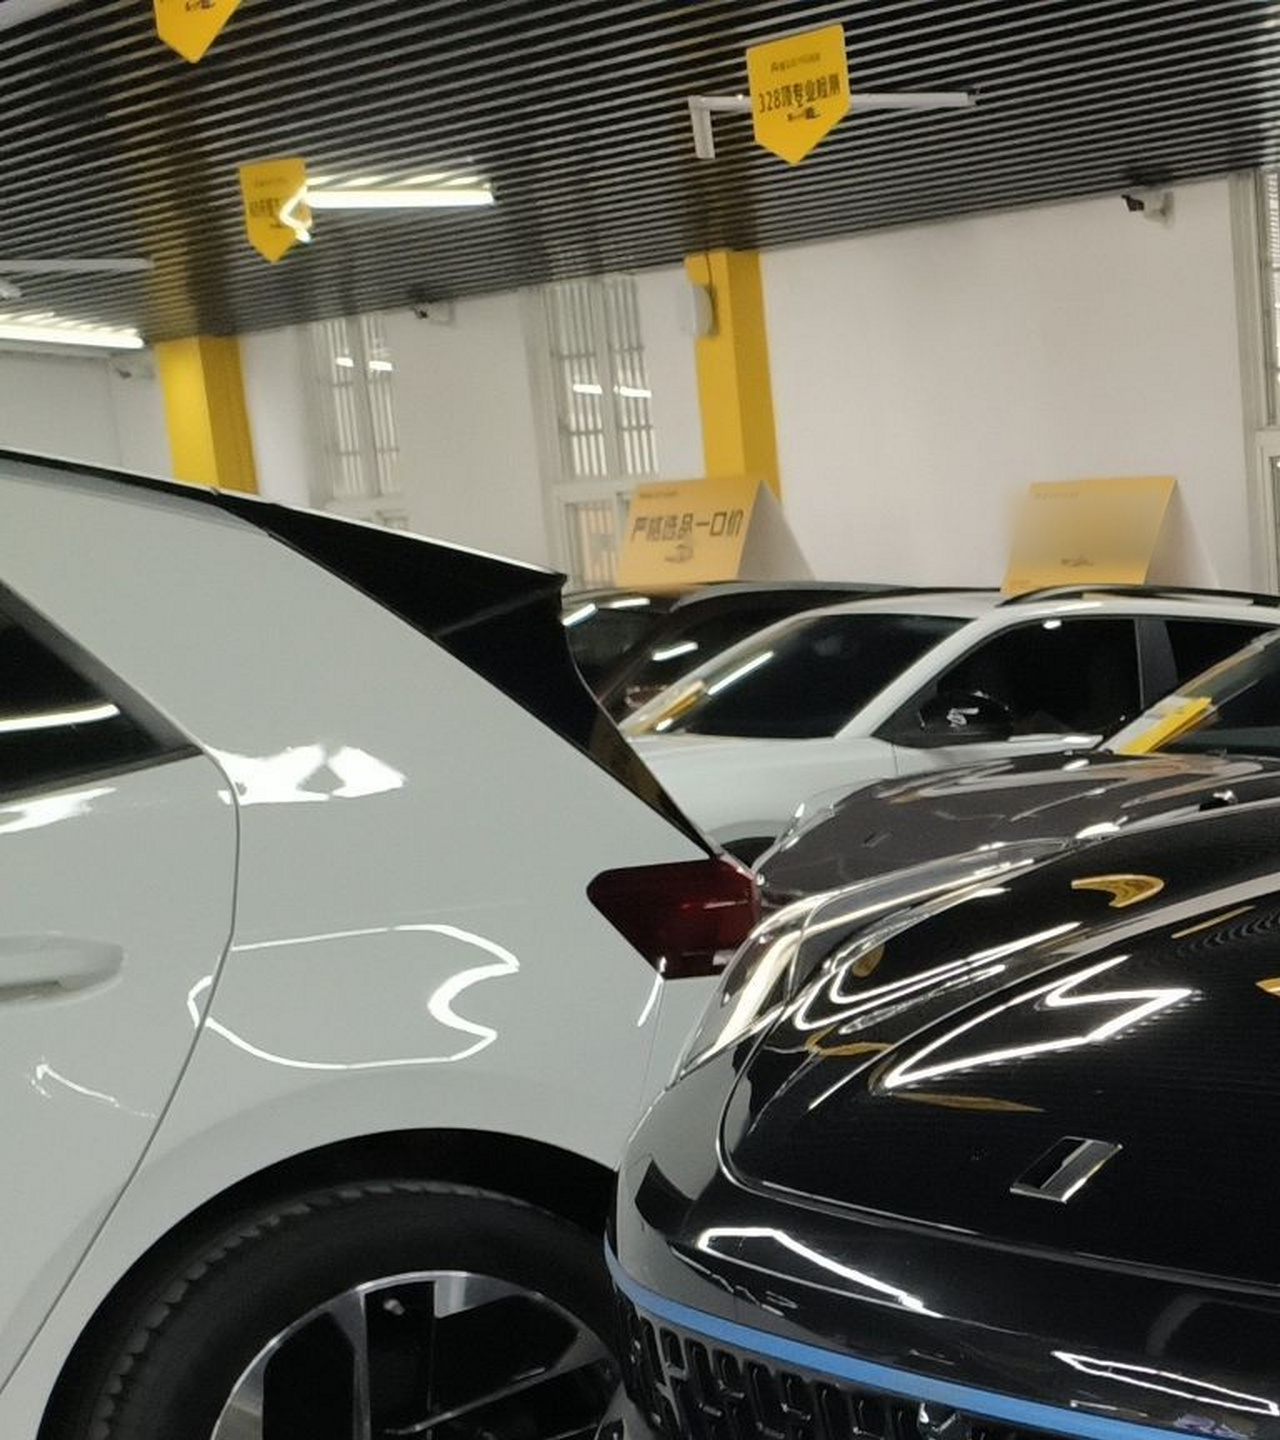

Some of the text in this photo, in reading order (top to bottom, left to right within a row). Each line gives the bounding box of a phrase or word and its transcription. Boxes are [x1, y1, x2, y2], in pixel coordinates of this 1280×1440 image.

[631, 508, 744, 542] 严格选品一口价
